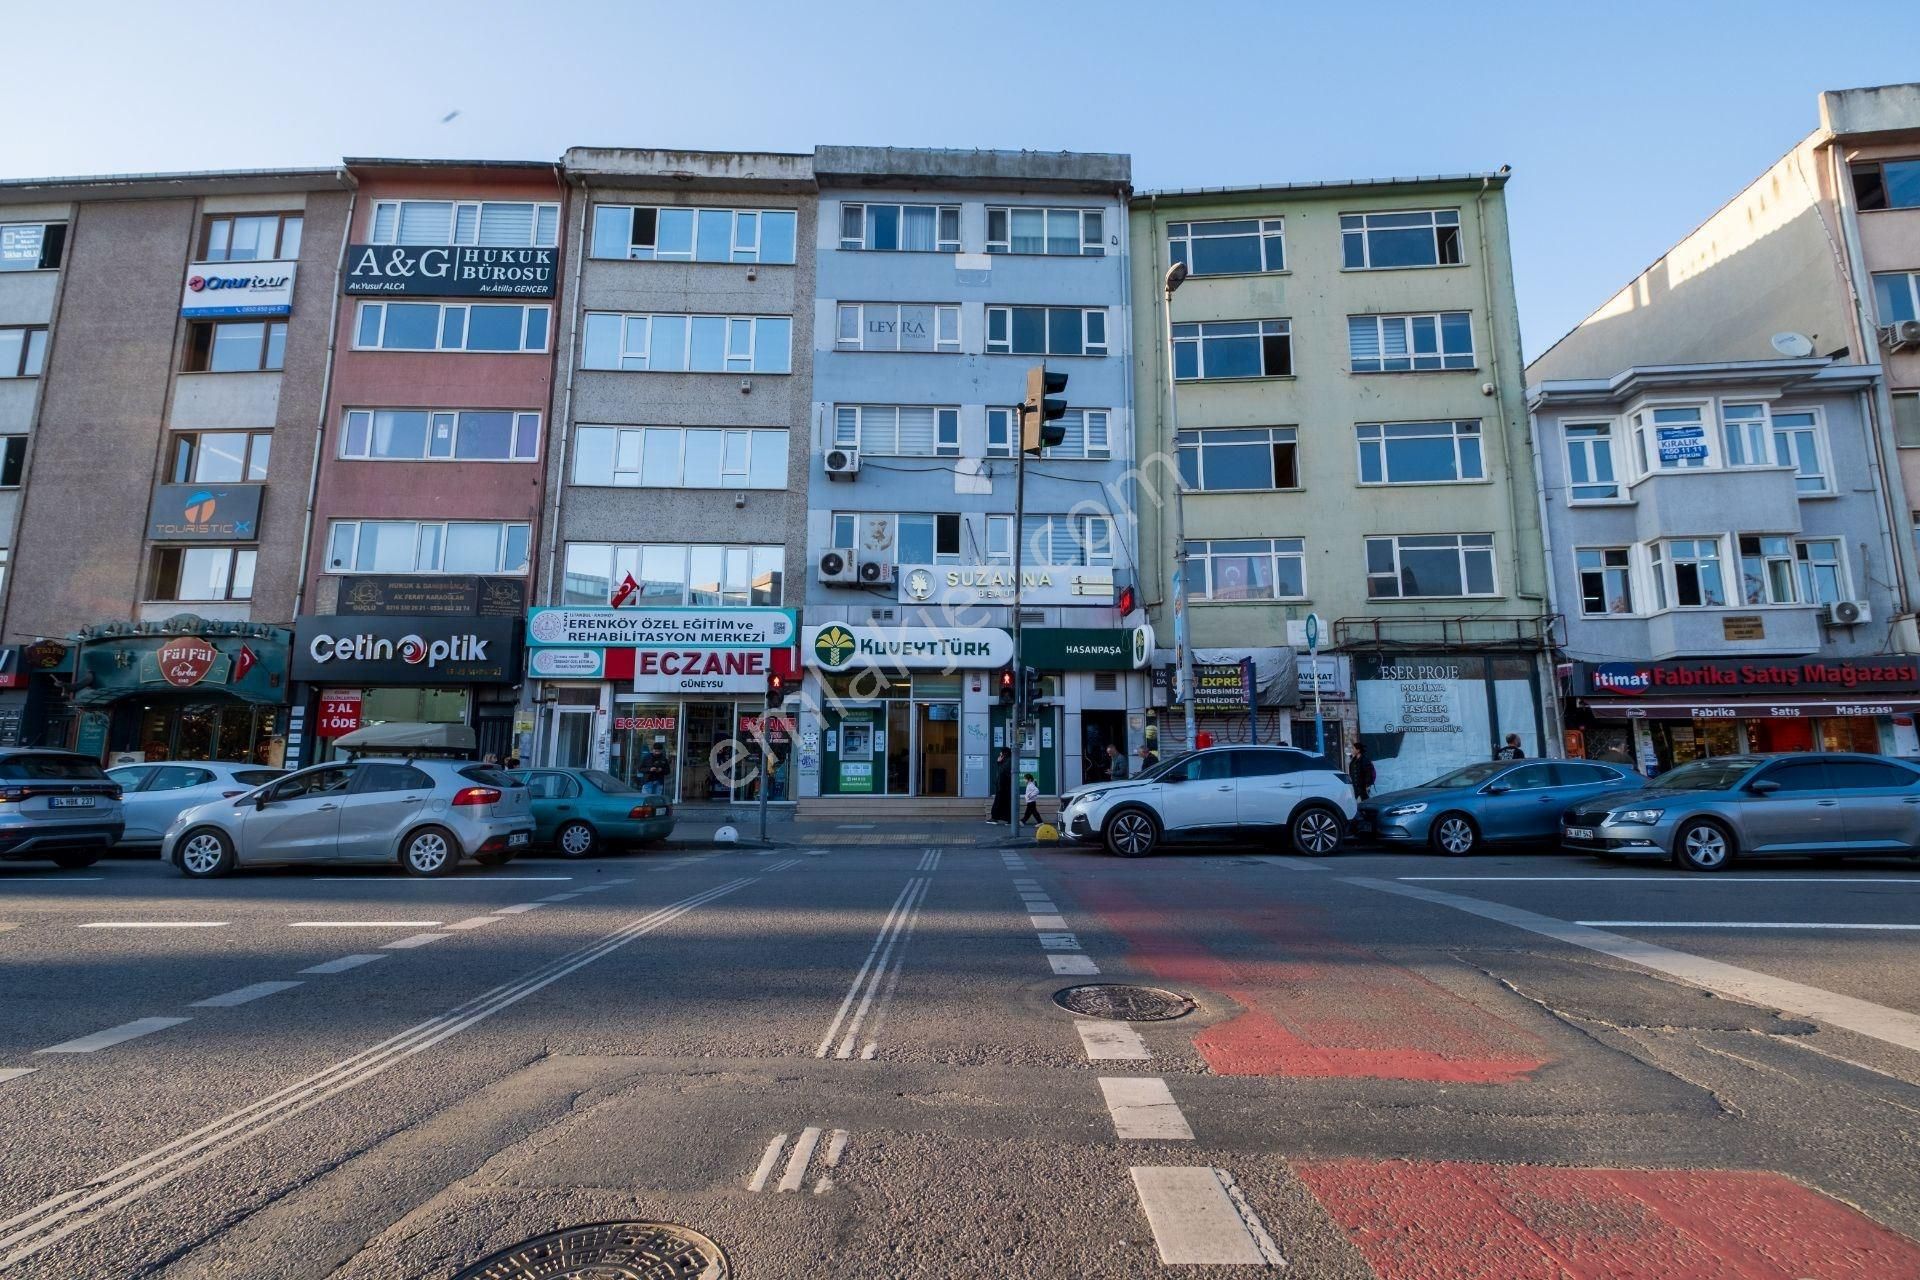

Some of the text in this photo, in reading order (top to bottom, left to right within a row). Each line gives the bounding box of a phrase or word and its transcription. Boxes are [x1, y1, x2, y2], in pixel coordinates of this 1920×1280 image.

[351, 248, 450, 277] A&G
[464, 249, 550, 264] HUKUK
[462, 264, 550, 281] BÜROSU
[514, 285, 549, 294] GENÇER
[869, 321, 925, 333] LEYRA
[946, 571, 1052, 587] SUZANNA
[569, 617, 636, 629] ERENKÖY
[642, 618, 679, 629] ÖZEL
[683, 618, 734, 630] EĞİTİM
[568, 630, 766, 642] REHABİLİTASYON MERKEZİ
[162, 648, 212, 663] Fül Fül
[397, 634, 491, 668] Optik
[1066, 645, 1122, 656] HASANPAŞA
[640, 652, 765, 676] ECZANE
[1381, 666, 1460, 680] ESER PROJE
[1594, 662, 1917, 687] itimat Fabrika Satış Mağazası
[680, 678, 724, 688] GÜNEYSU
[1400, 682, 1446, 692] MOBİLYA
[1404, 691, 1442, 702] İMALAT
[327, 703, 353, 713] 2 AL
[1403, 704, 1448, 713] TASARIM
[1691, 705, 1893, 717] Fabrika Satış Mağazası
[322, 715, 357, 728] 1 ÖDE
[615, 717, 676, 730] ECZANE
